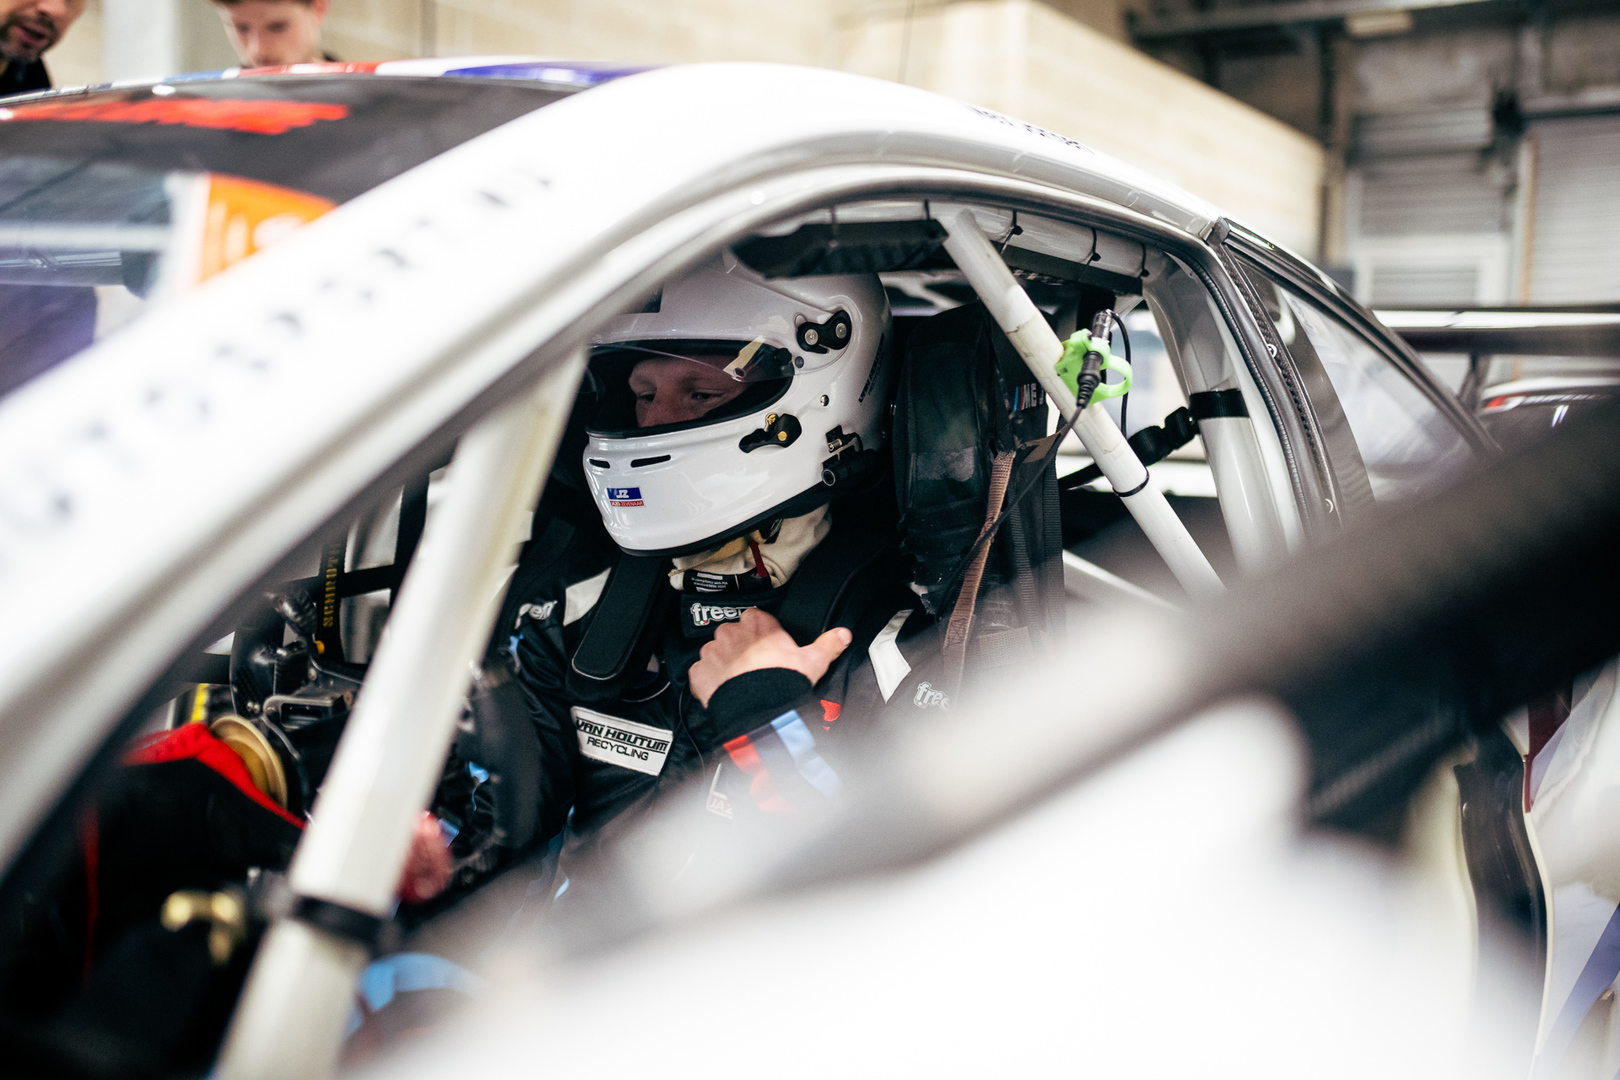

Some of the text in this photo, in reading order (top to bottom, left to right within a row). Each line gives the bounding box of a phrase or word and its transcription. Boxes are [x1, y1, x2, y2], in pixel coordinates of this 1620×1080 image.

[576, 717, 670, 754] VAN HOUTUM
[587, 736, 649, 761] RECYCLING
